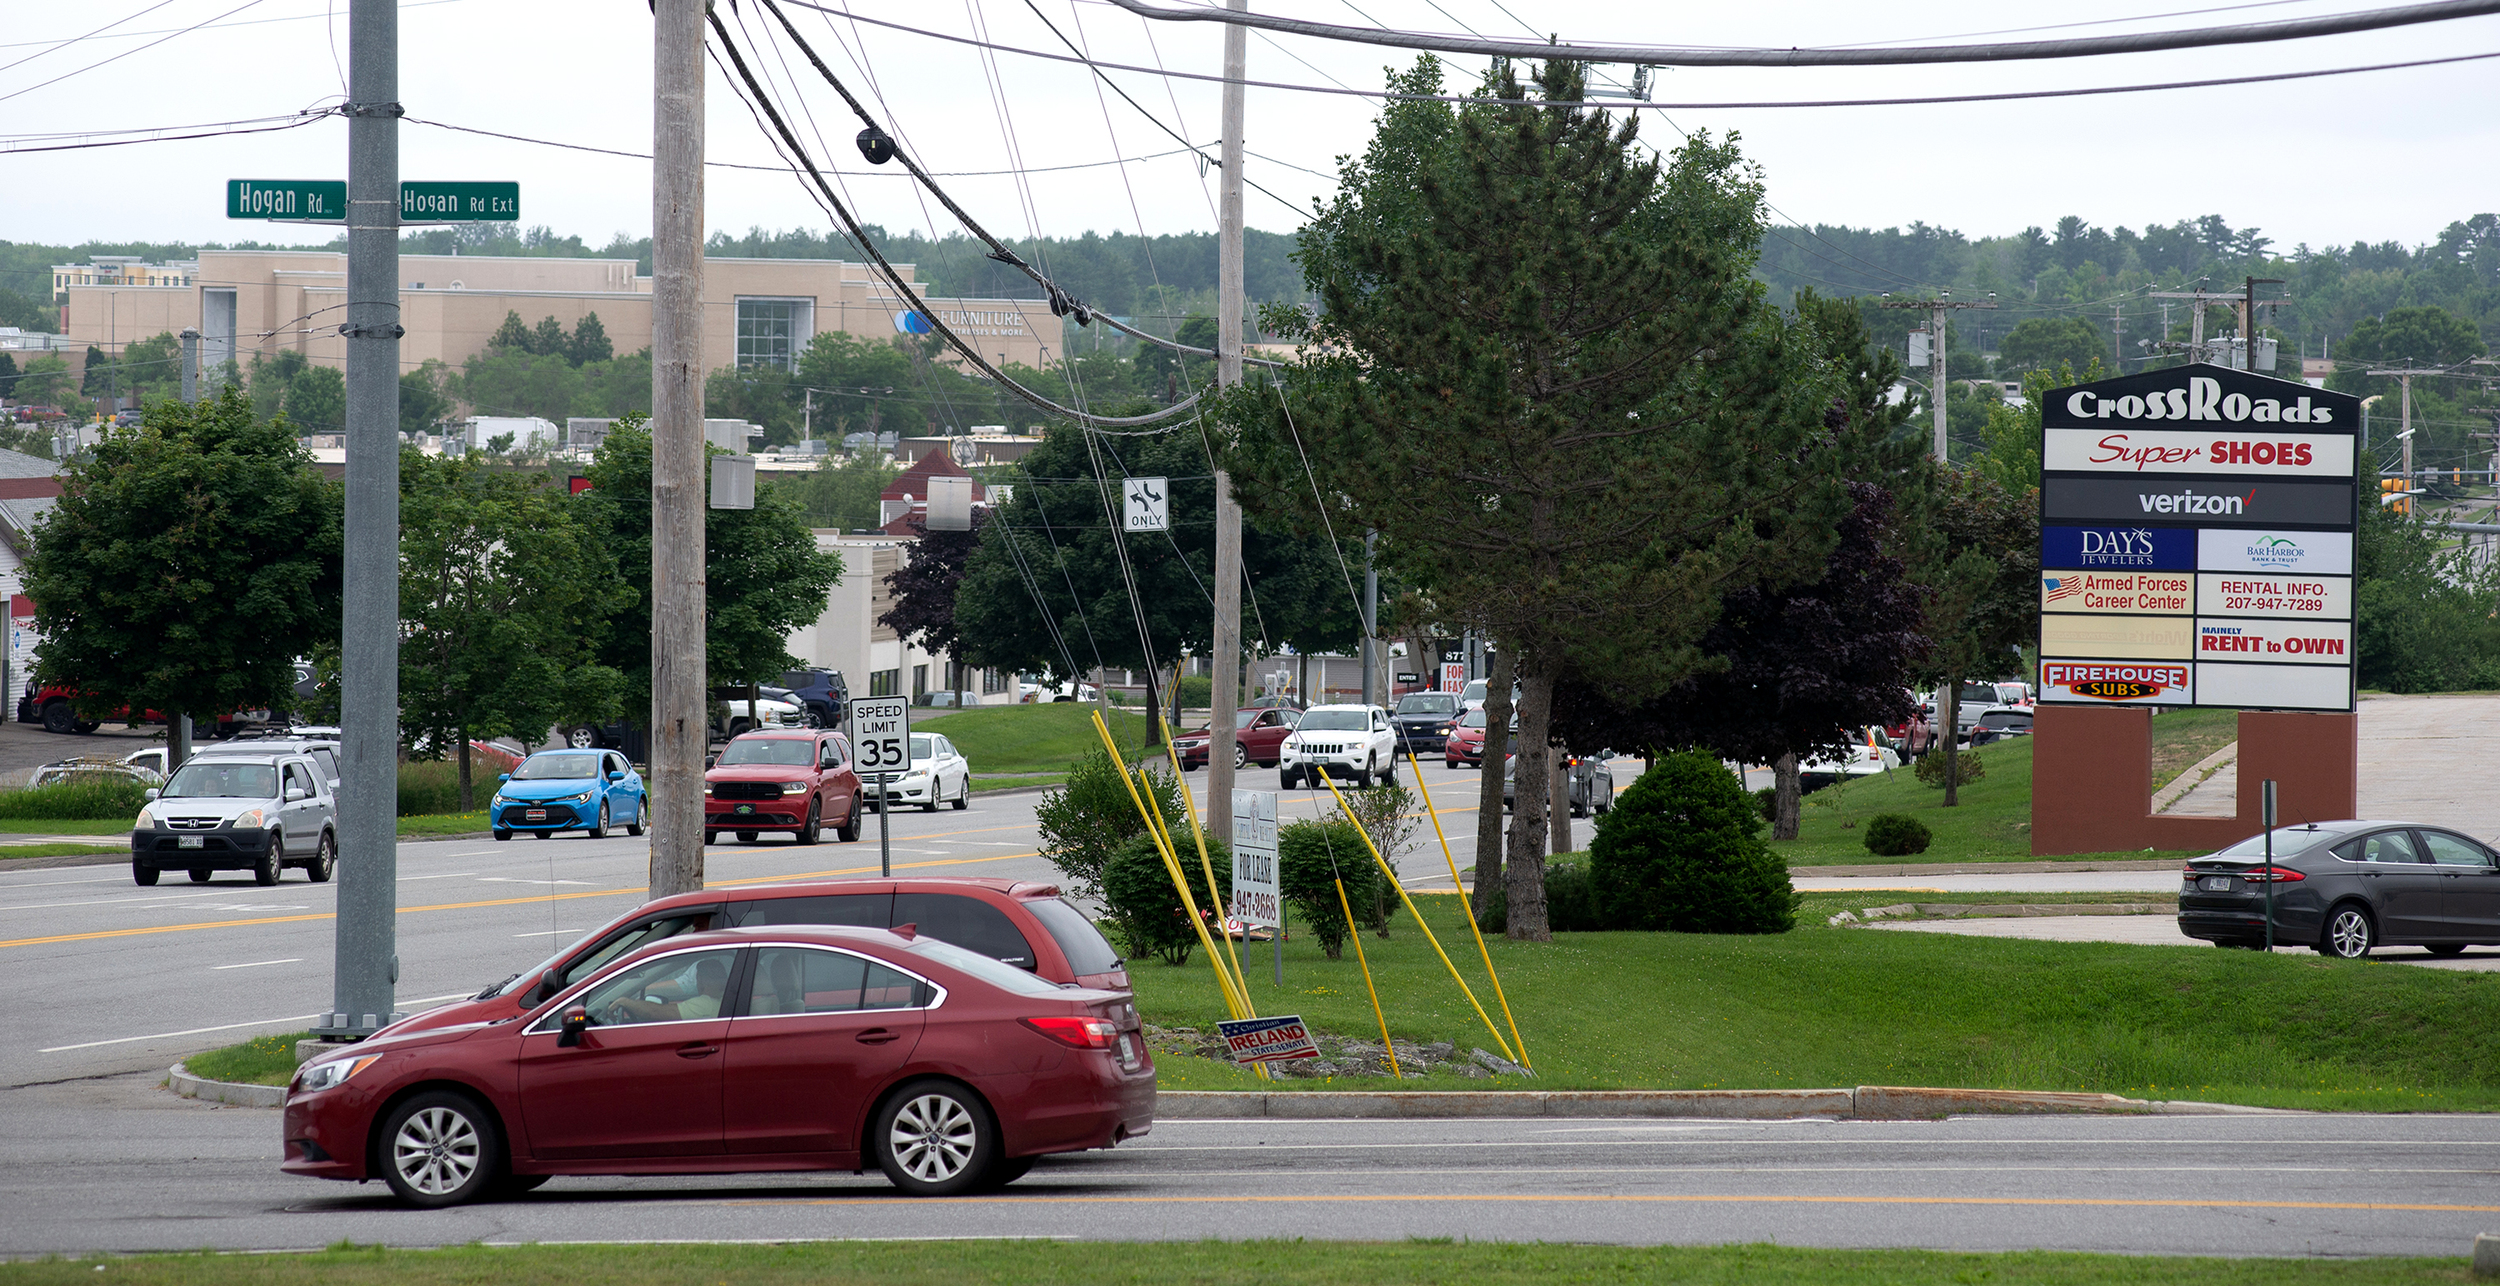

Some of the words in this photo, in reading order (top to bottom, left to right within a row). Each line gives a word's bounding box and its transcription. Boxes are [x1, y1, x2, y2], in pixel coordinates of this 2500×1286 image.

[240, 182, 296, 214] Hogan
[308, 193, 323, 213] Rd
[404, 190, 458, 213] Hogan
[470, 196, 485, 212] Rd
[492, 197, 513, 212] Ext
[940, 310, 1023, 326] FURNITURE
[950, 327, 988, 336] TTRESSES
[2067, 376, 2333, 424] CrossRoads
[2089, 434, 2201, 471] Super
[2209, 440, 2312, 466] SHOES
[2139, 489, 2243, 515] verizon
[1131, 515, 1162, 526] ONLY
[2081, 555, 2154, 565] JEWELERS
[2247, 546, 2265, 556] BAR
[2266, 546, 2305, 557] HARBOR
[2085, 575, 2133, 591] Armed
[2138, 576, 2188, 592] Forces
[2221, 581, 2282, 595] RENTAL
[2287, 583, 2328, 596] INFO.
[2084, 592, 2134, 609] Career
[2138, 593, 2187, 610] Center
[2225, 596, 2323, 611] 207-947-7289
[2202, 627, 2242, 635] MAINELY
[2201, 635, 2264, 653] RENT
[2266, 640, 2282, 653] to
[2284, 637, 2344, 655] OWN
[2047, 665, 2184, 692] FIREHOUSE
[1443, 681, 1463, 694] LEAS
[2090, 682, 2140, 697] SUBS
[857, 705, 902, 718] SPEED
[863, 721, 897, 733] LIMIT
[860, 738, 902, 767] 35
[1239, 852, 1251, 882] FOR
[1252, 854, 1272, 885] LEASE
[1236, 889, 1277, 922] 947-2668
[1240, 1020, 1280, 1032] Christian
[1228, 1025, 1306, 1052] IRELAND
[1251, 1045, 1276, 1056] STATE
[1275, 1039, 1308, 1051] SENATE
